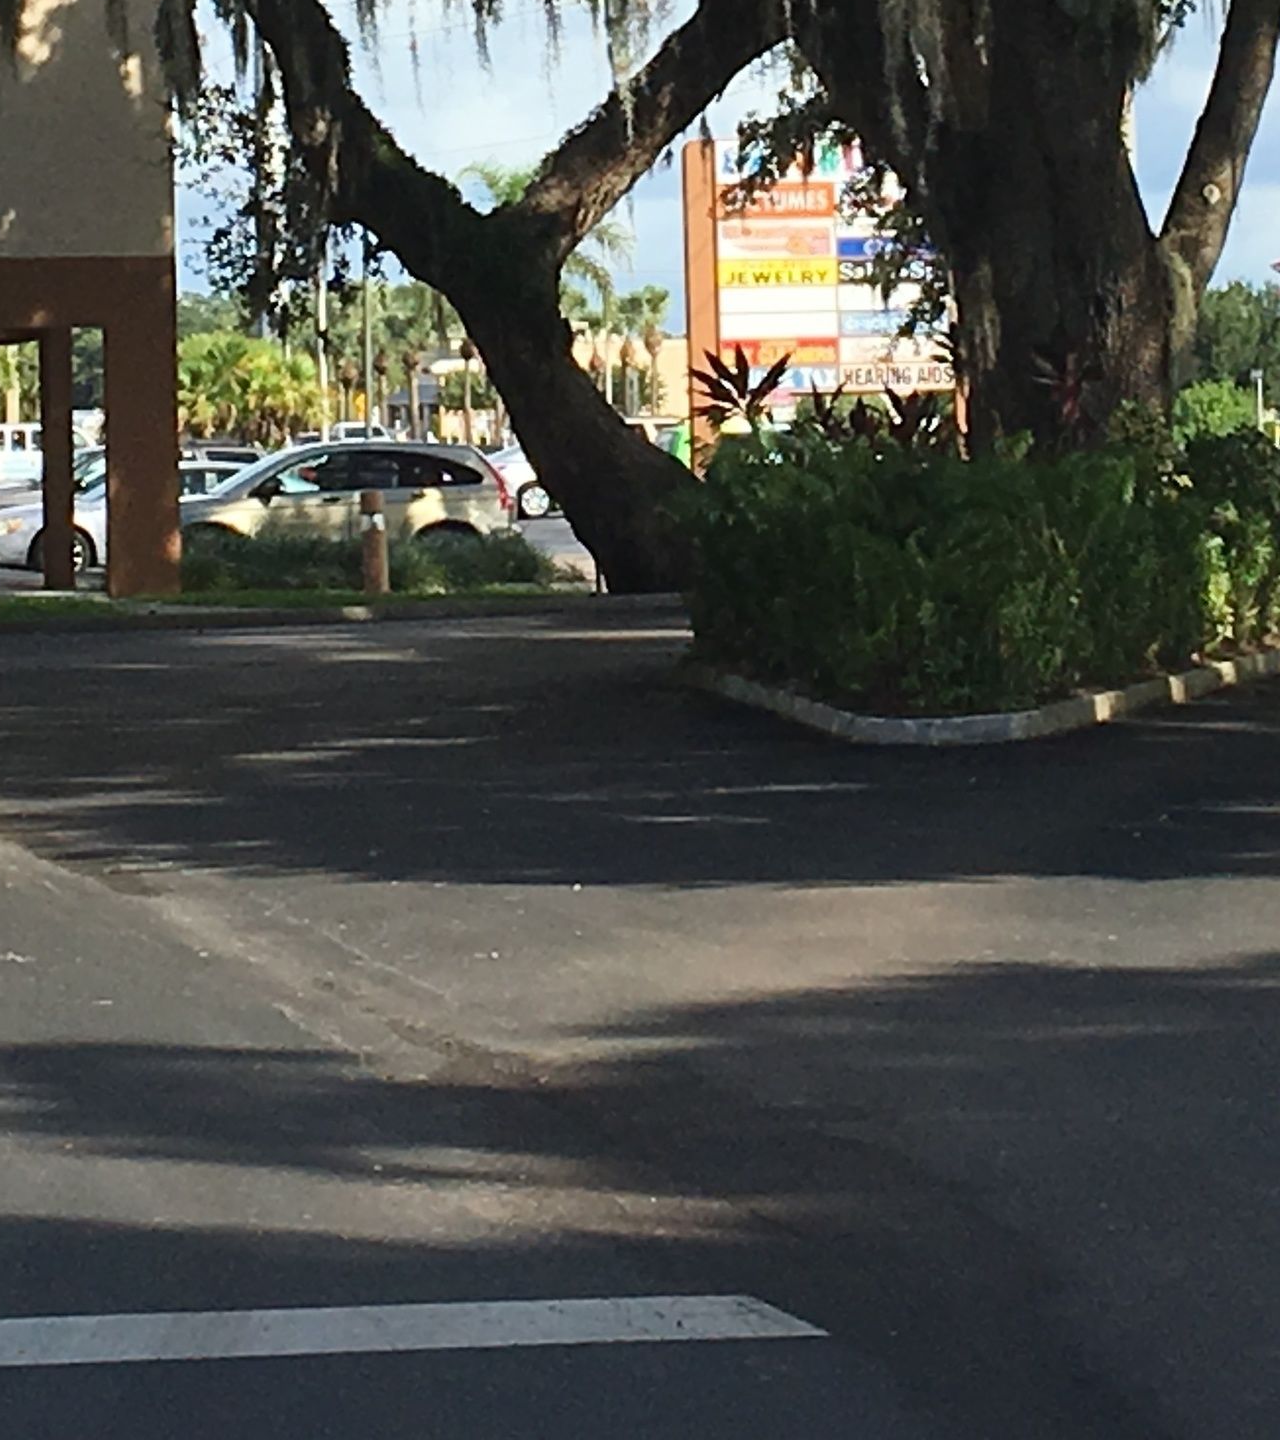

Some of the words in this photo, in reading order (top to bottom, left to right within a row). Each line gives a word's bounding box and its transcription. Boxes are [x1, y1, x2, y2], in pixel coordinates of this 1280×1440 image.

[725, 270, 828, 284] JEWELRY
[843, 366, 912, 385] HEARING
[917, 365, 955, 384] AIDS
